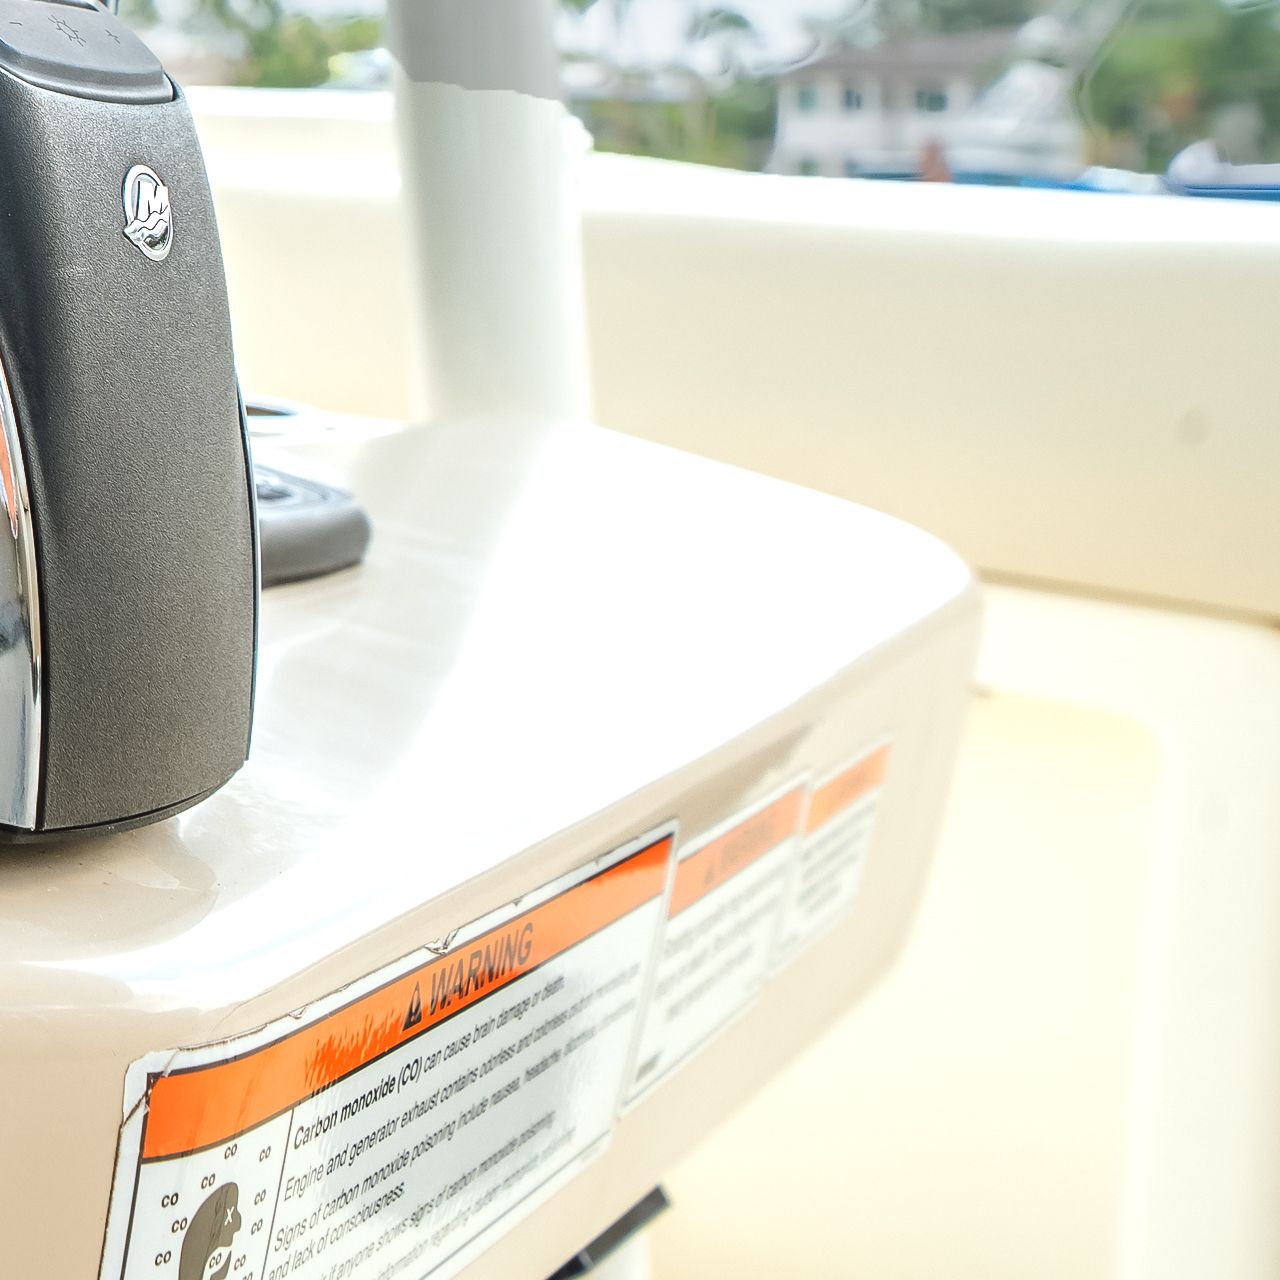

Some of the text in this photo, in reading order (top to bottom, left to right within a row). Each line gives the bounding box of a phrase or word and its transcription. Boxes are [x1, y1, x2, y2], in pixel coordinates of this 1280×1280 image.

[428, 921, 534, 1017] WARNING
[284, 1164, 324, 1201] Engine
[327, 1144, 348, 1175] and
[349, 1117, 400, 1166] generator
[401, 1089, 439, 1128] exhaust
[440, 1068, 478, 1103] contains
[294, 1110, 338, 1149] Carbon
[340, 1075, 395, 1123] monoxide
[398, 1057, 422, 1093] (CO)
[424, 1050, 442, 1073] can
[444, 1033, 471, 1061] cause
[275, 1219, 307, 1252] Signs
[309, 1203, 322, 1229] of
[323, 1184, 359, 1220] carbon
[361, 1150, 409, 1194] monoxide
[410, 1121, 456, 1167] poisoning
[458, 1098, 488, 1129] include
[269, 1182, 404, 1280] and lack of consciousness.
[337, 1242, 375, 1280] anyone
[376, 1217, 408, 1252] shows
[410, 1199, 434, 1227] signs
